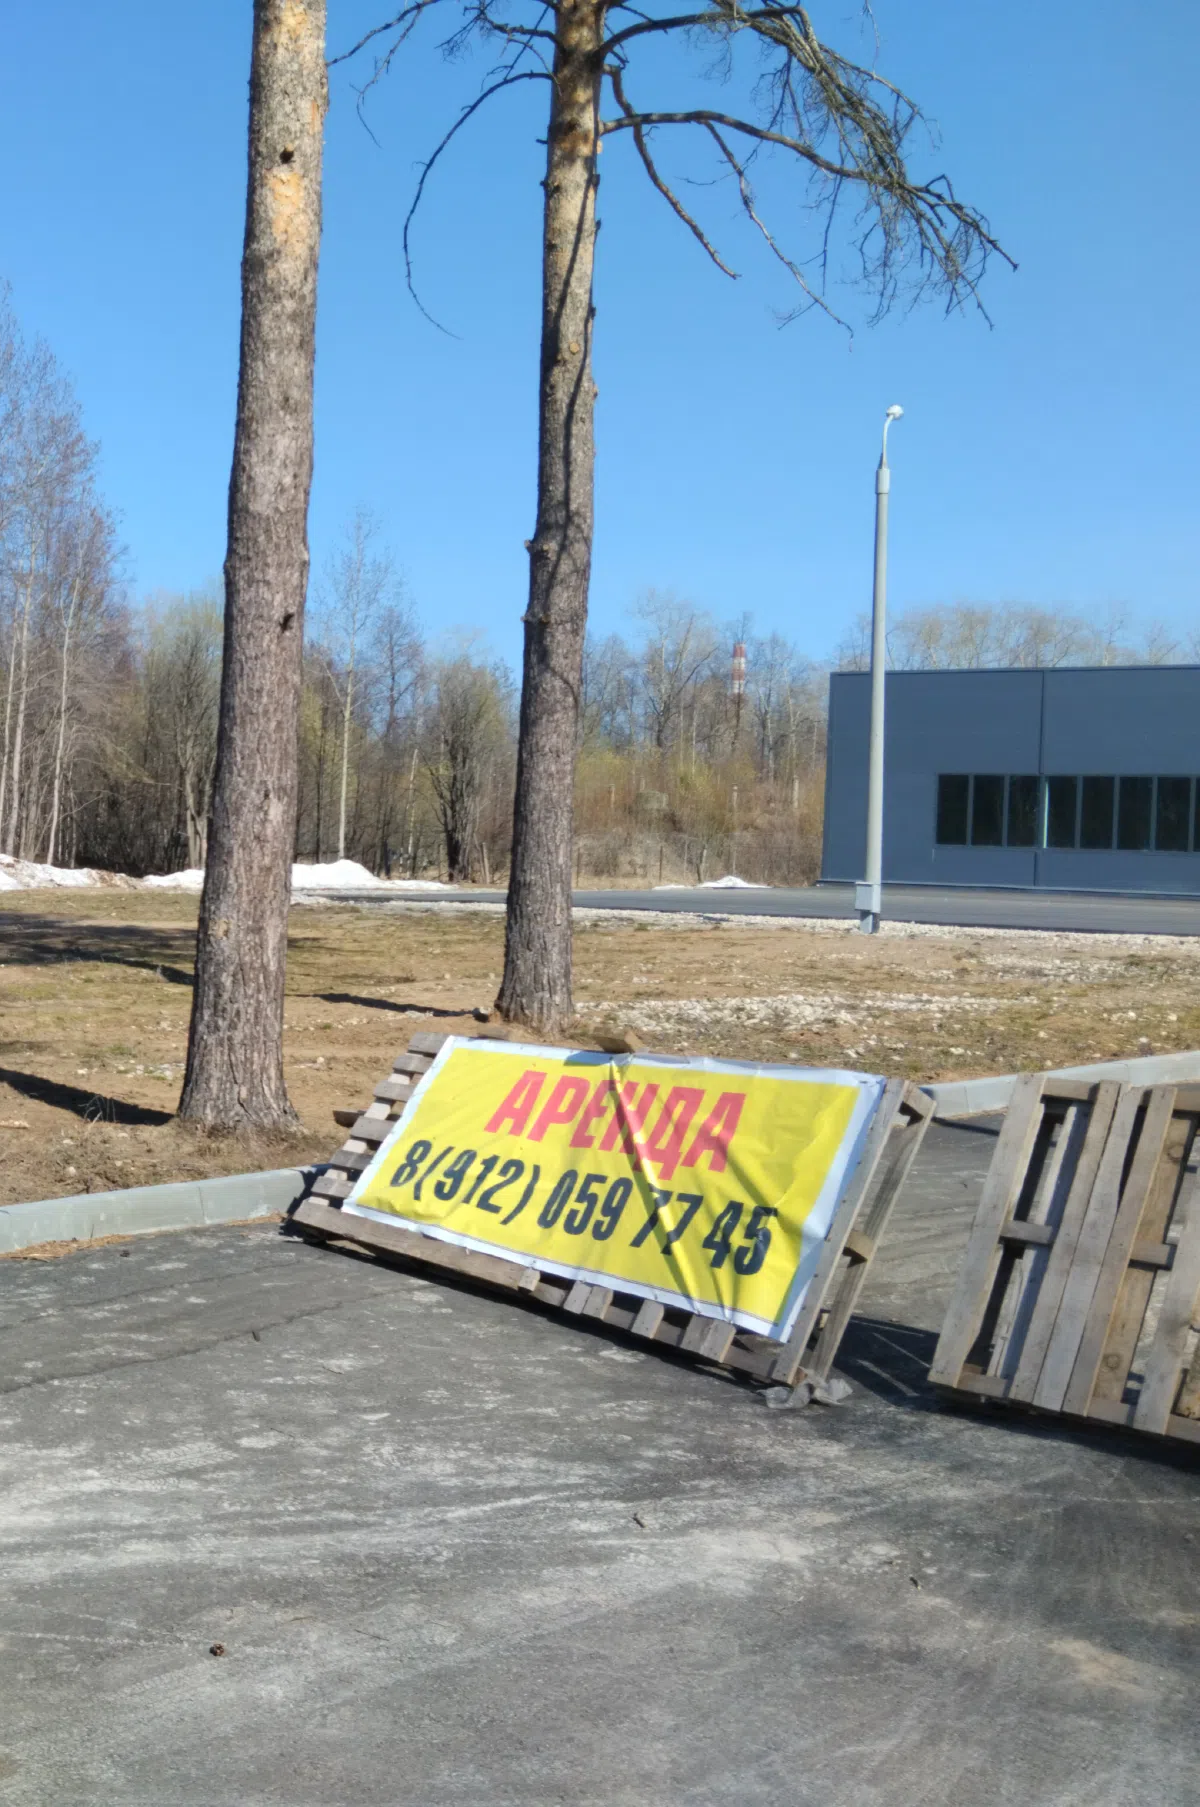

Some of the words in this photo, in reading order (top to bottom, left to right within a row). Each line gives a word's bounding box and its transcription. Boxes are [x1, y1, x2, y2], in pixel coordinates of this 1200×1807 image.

[484, 1070, 747, 1181] АРЕНДА
[390, 1139, 540, 1225] 8(912)
[537, 1169, 633, 1241] 059
[702, 1200, 778, 1275] 45
